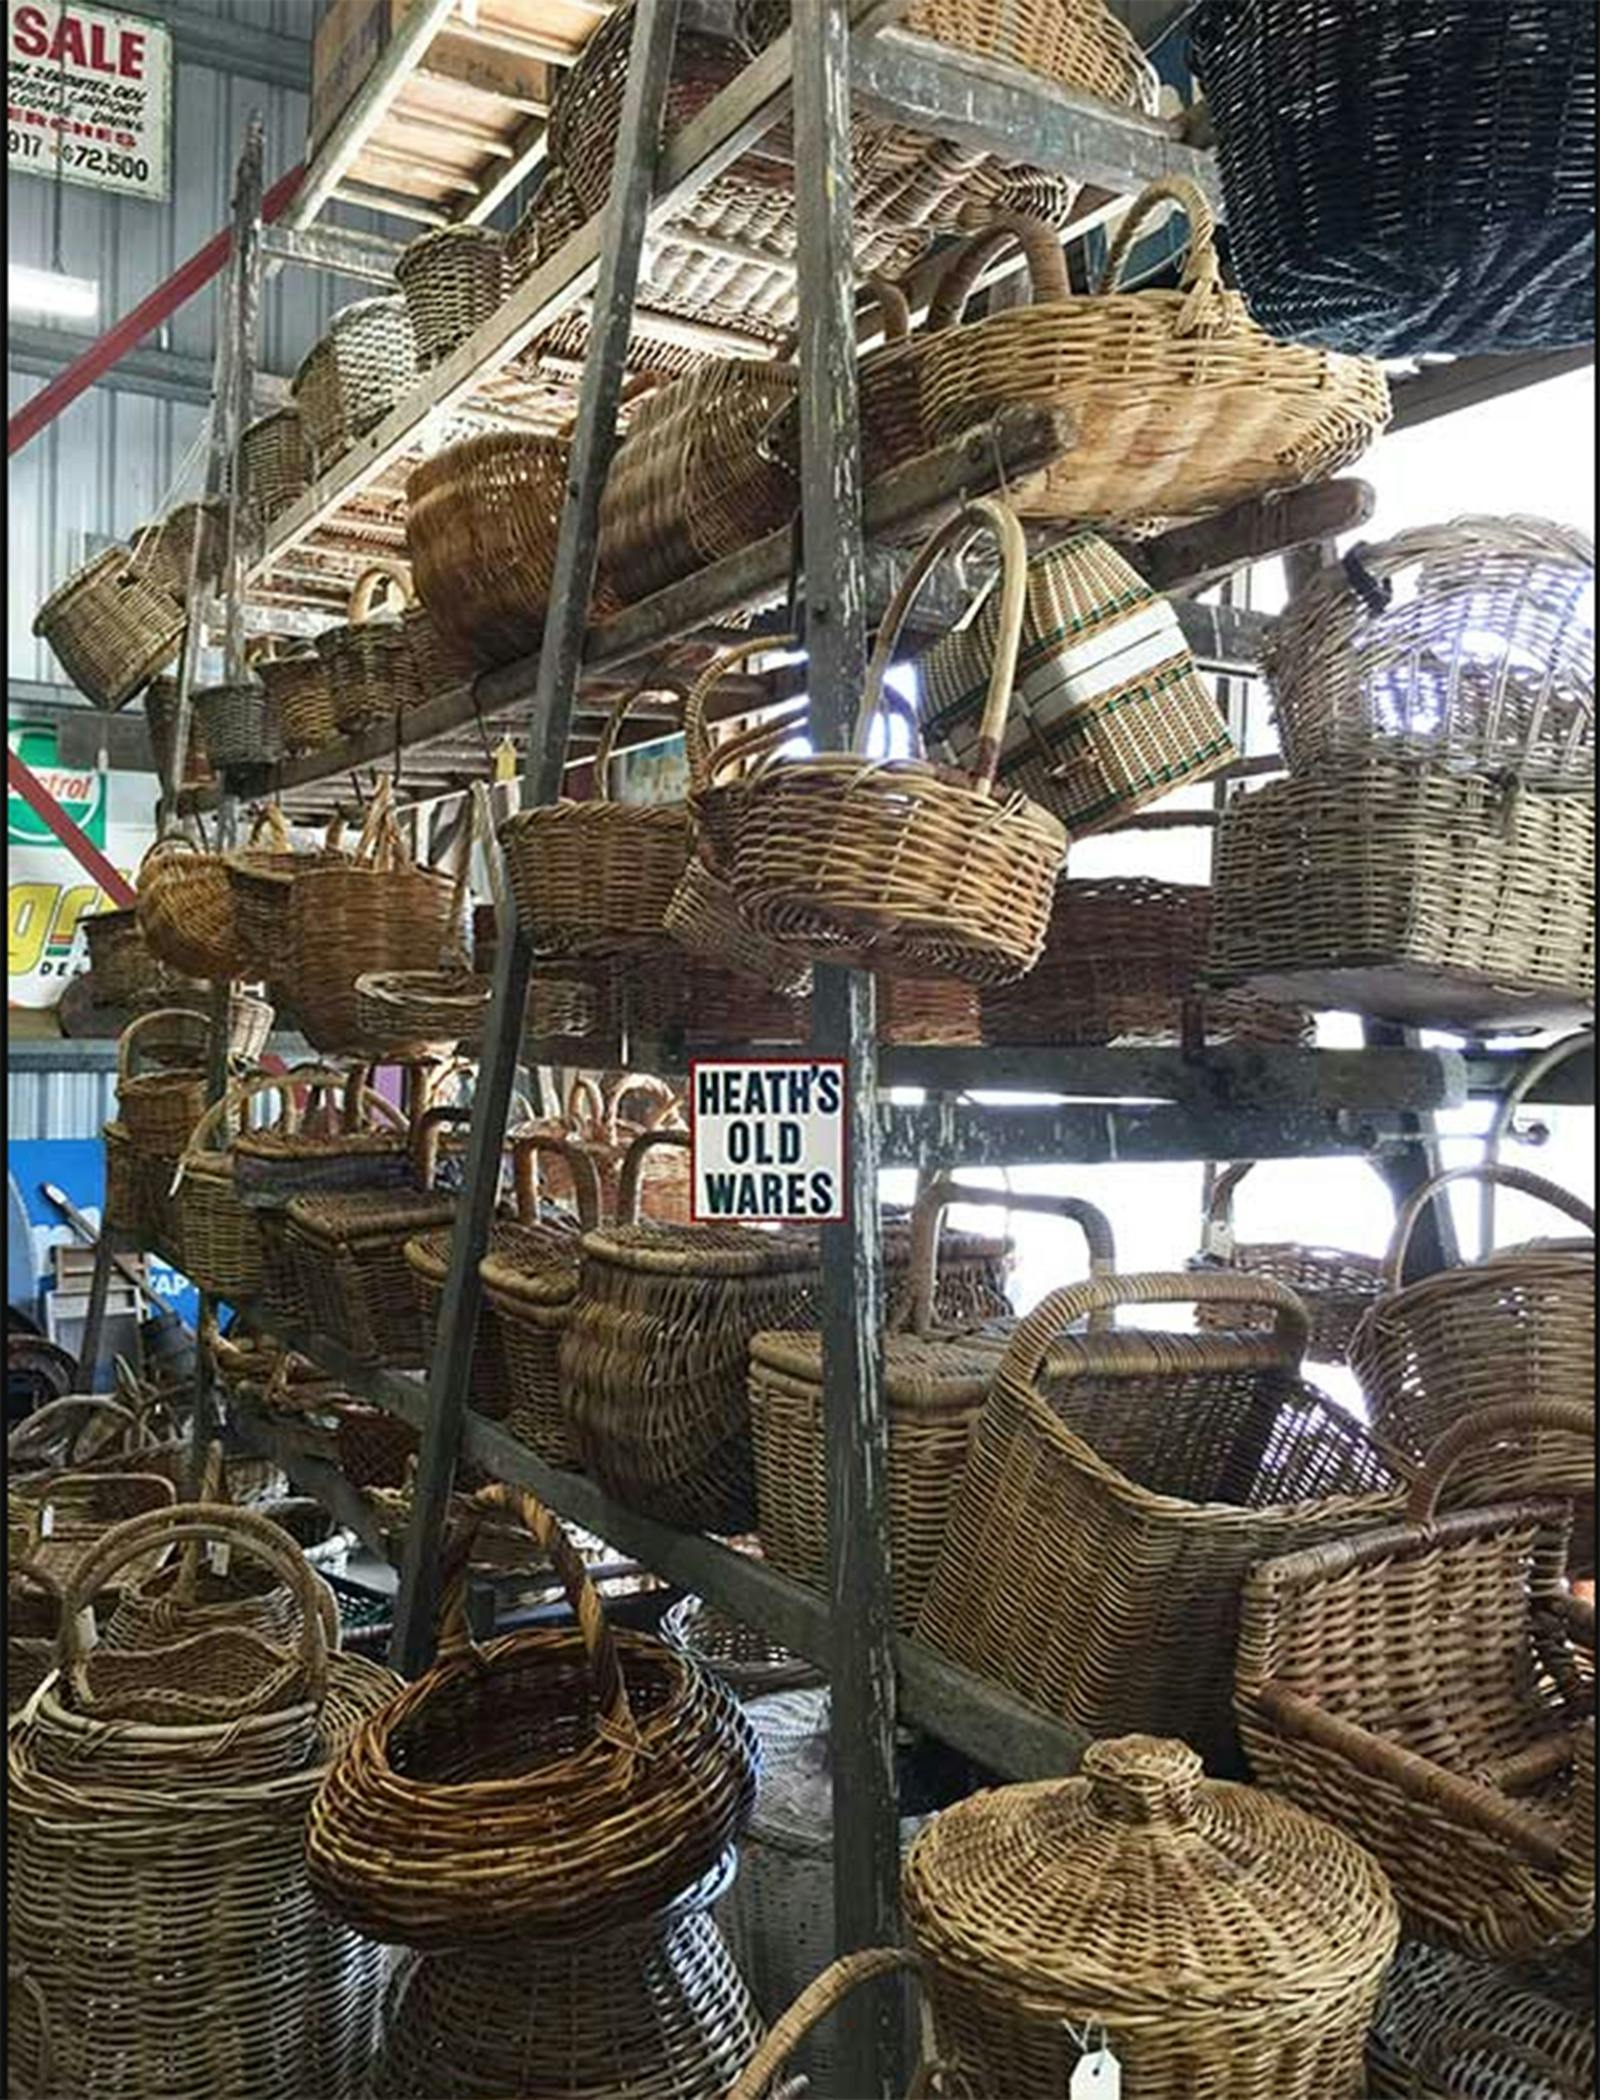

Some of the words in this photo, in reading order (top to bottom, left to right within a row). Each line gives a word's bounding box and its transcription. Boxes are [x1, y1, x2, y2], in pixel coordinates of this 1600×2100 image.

[13, 6, 145, 80] SALE
[698, 1065, 840, 1115] HEATH'S
[728, 1121, 801, 1165] OLD
[705, 1172, 833, 1215] WARES
